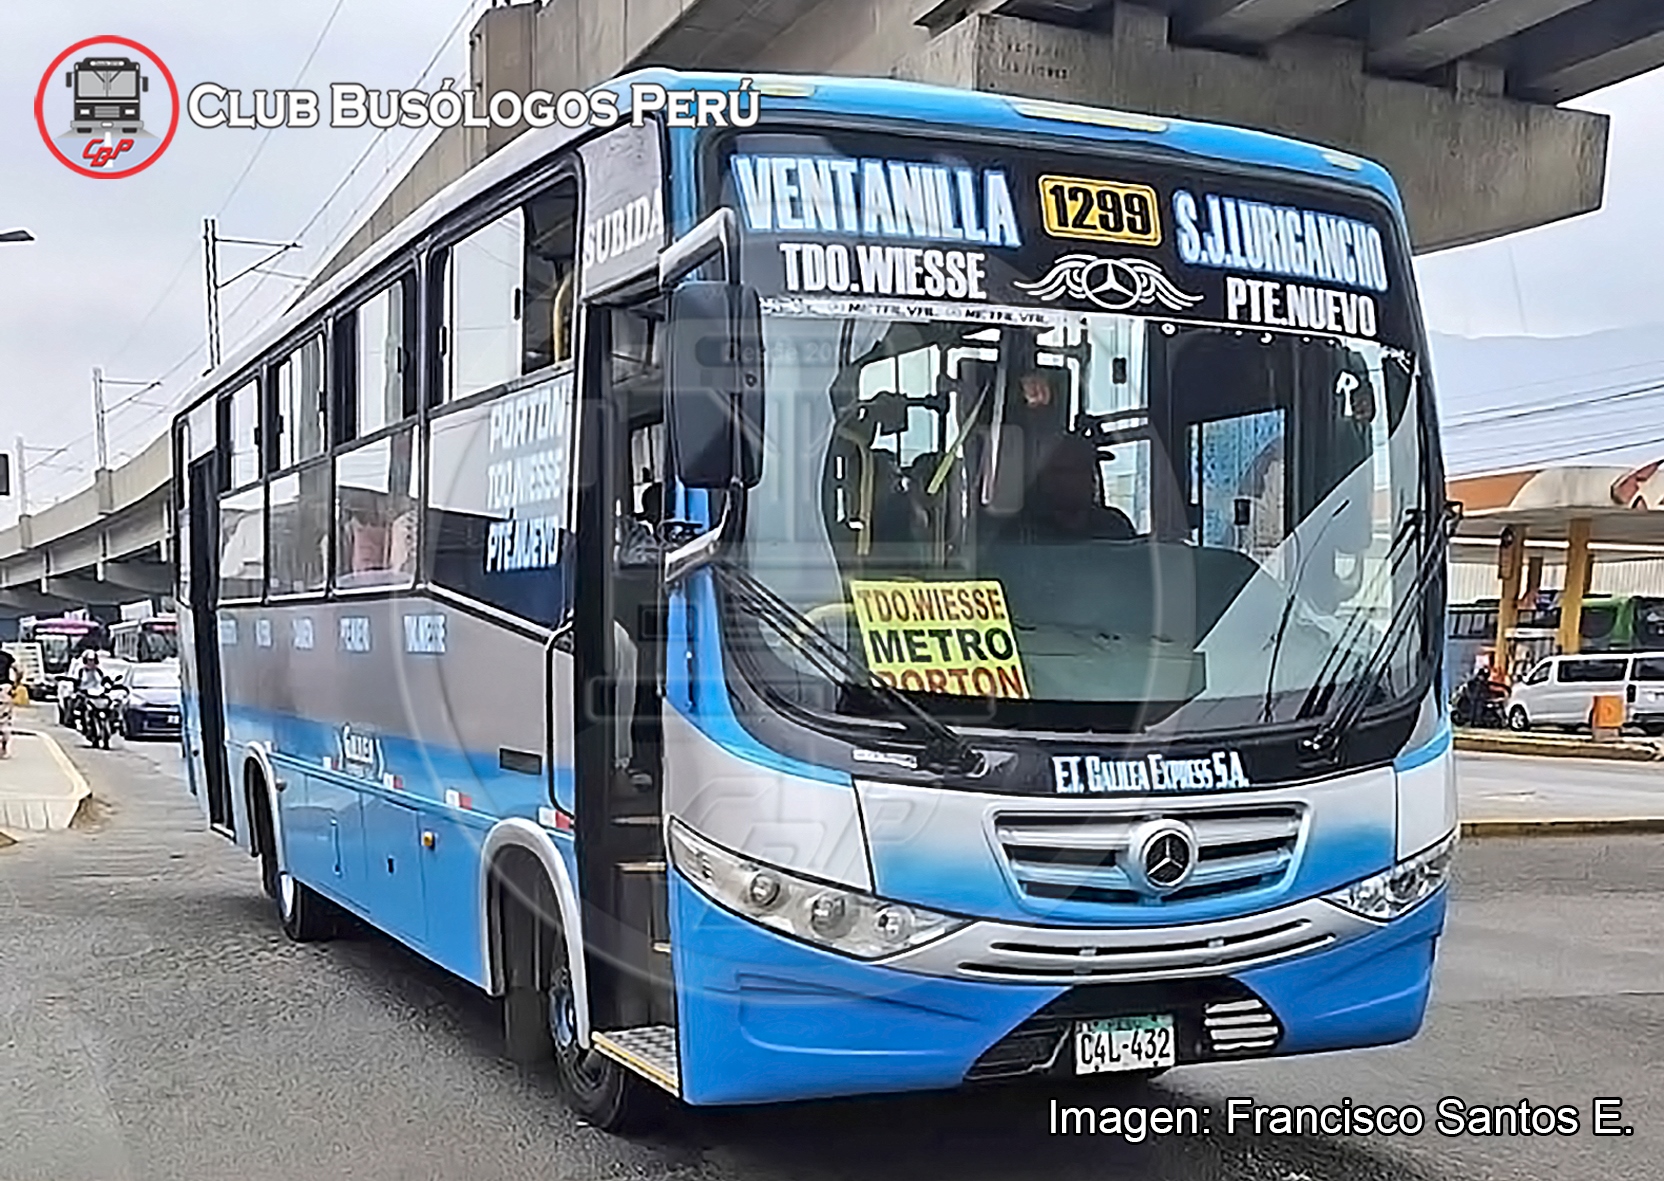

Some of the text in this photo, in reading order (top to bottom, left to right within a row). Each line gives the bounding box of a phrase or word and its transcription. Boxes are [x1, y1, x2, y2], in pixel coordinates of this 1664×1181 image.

[582, 187, 664, 269] SUBIDA
[730, 155, 1021, 248] VENTANILLA
[1049, 184, 1150, 236] 1299
[779, 242, 987, 299] TDO.WIESSE
[1226, 276, 1377, 337] PTE.NUEVO
[856, 588, 1005, 622] TDO.WIESSE
[868, 627, 1014, 663] METRO
[1081, 1027, 1170, 1065] C4L-432
